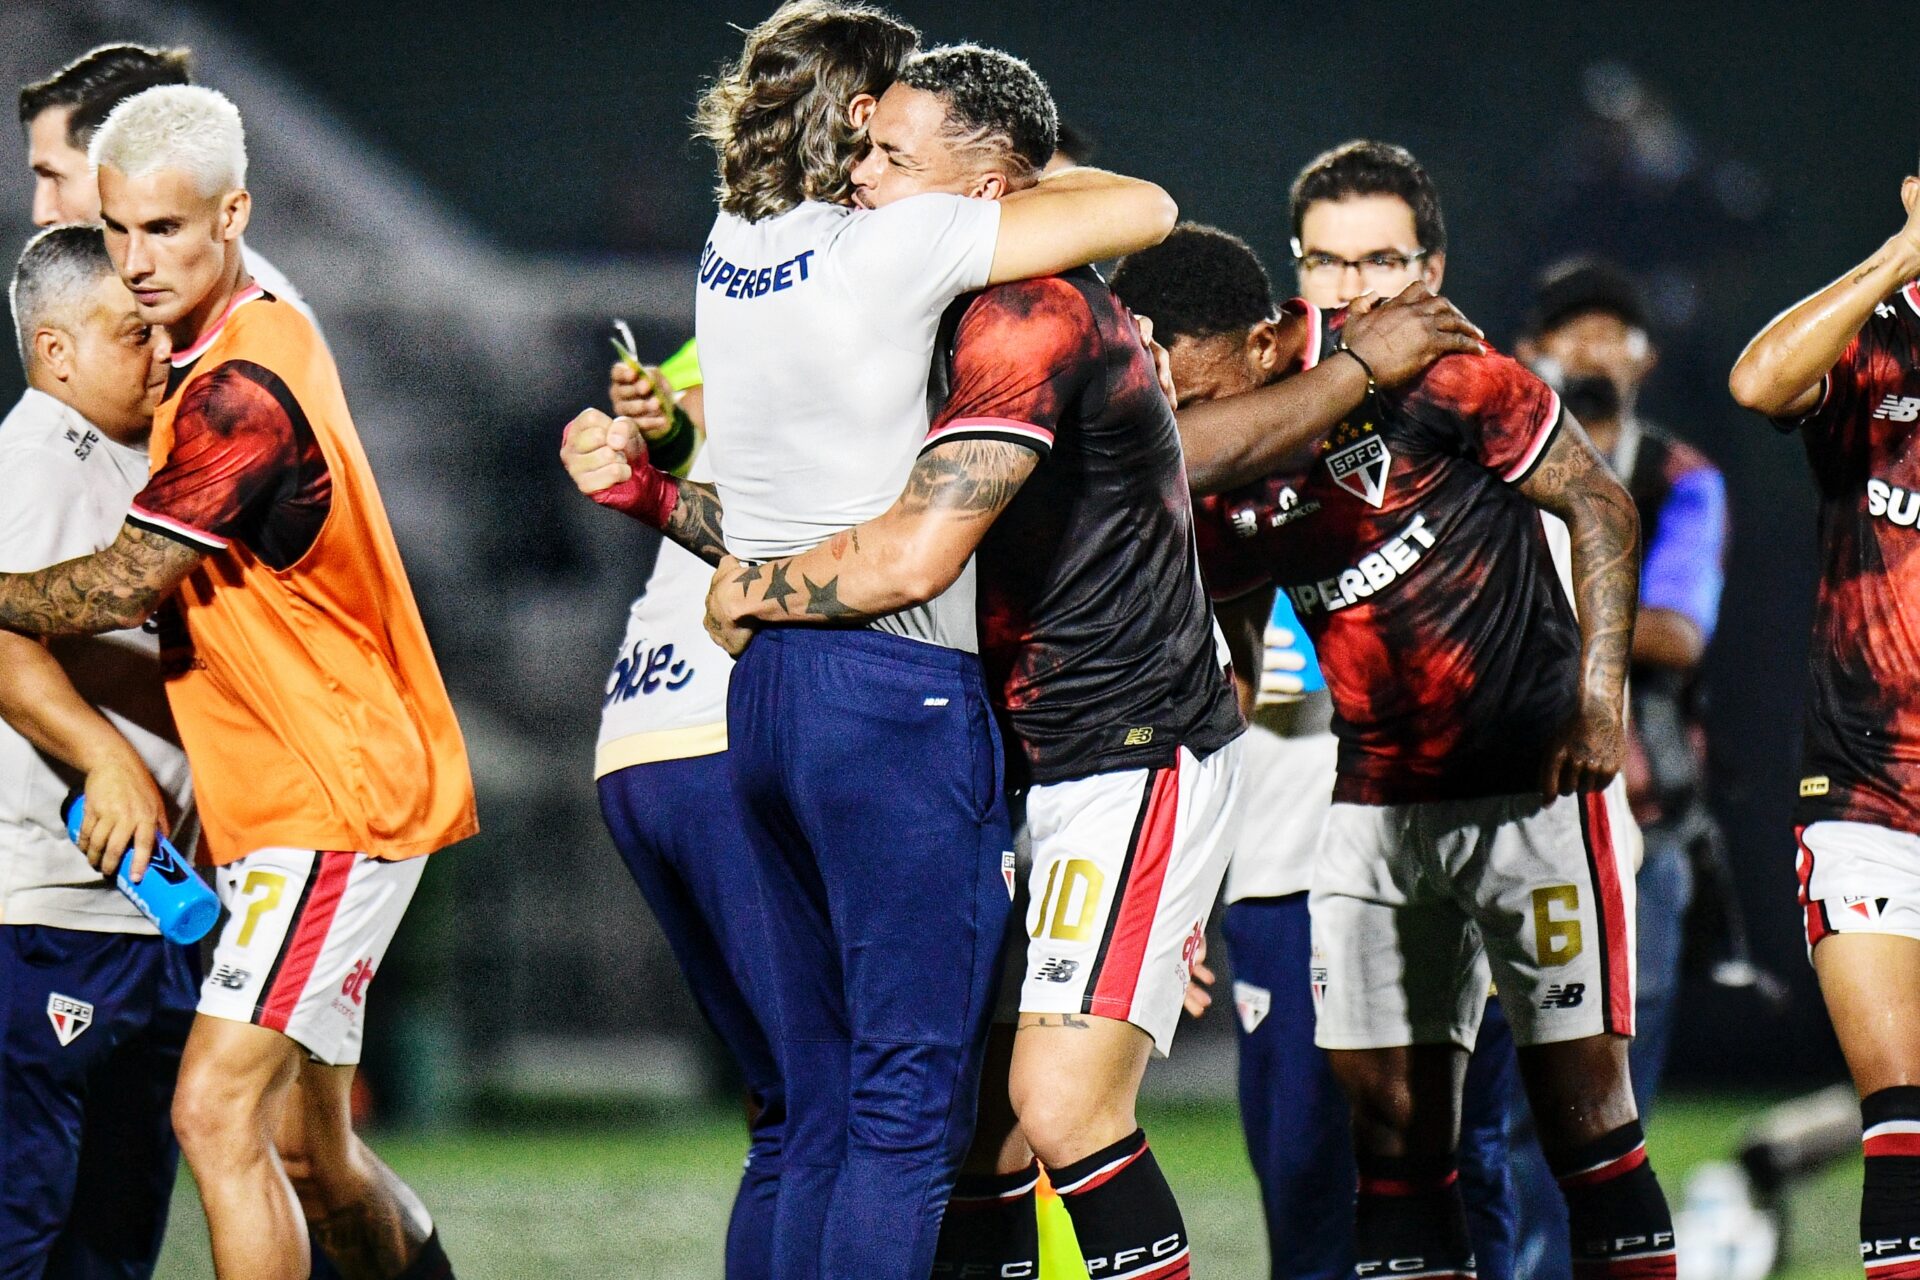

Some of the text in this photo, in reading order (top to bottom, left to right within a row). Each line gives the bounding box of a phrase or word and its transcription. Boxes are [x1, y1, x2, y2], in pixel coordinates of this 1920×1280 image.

[700, 240, 815, 299] SUPERBET
[1334, 443, 1380, 473] SPFC
[1867, 478, 1920, 530] SU
[236, 871, 287, 948] 7
[1031, 859, 1105, 942] 10
[1532, 884, 1583, 967] 6
[54, 1000, 90, 1019] SPFC
